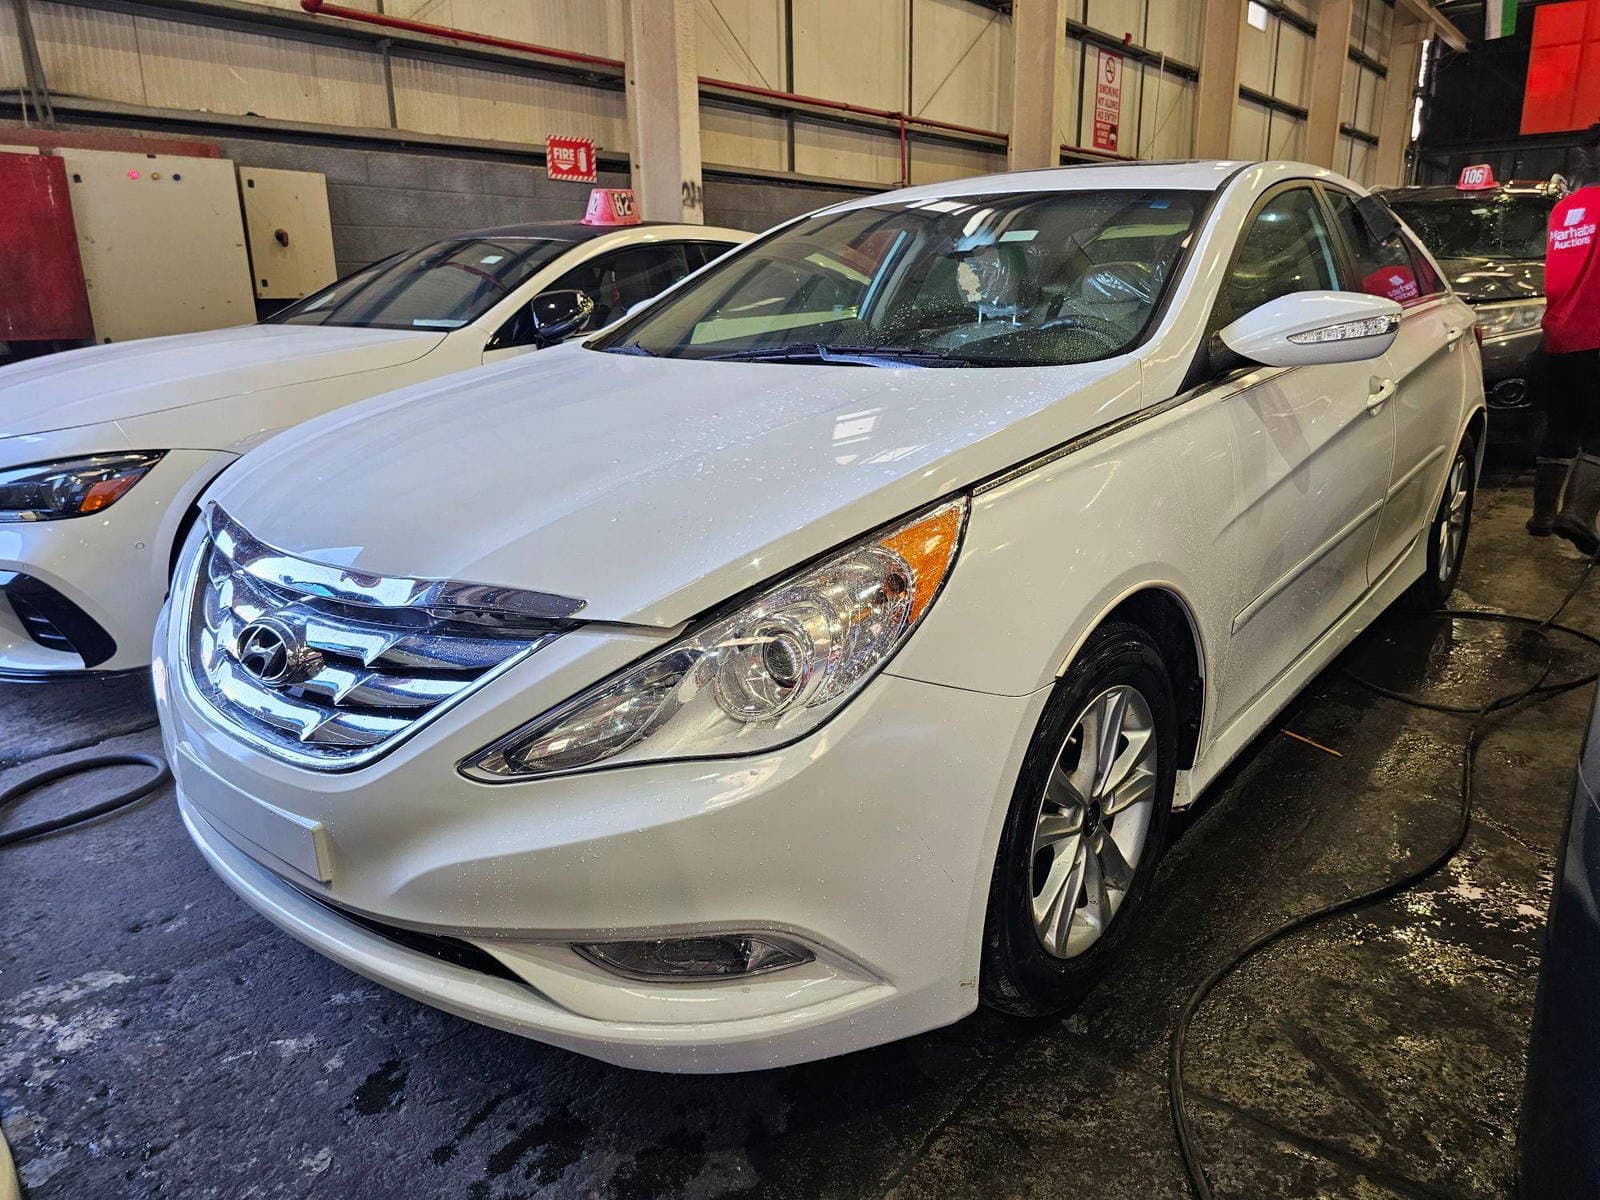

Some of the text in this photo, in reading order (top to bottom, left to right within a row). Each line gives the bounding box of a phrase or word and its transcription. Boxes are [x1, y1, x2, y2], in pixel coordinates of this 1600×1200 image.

[1098, 83, 1118, 98] SMOKING
[1097, 110, 1104, 120] NO
[553, 147, 575, 161] FIRE
[1464, 169, 1484, 184] 106
[614, 192, 632, 216] 82
[1550, 224, 1596, 241] Marhaba
[1553, 235, 1591, 251] Auctions
